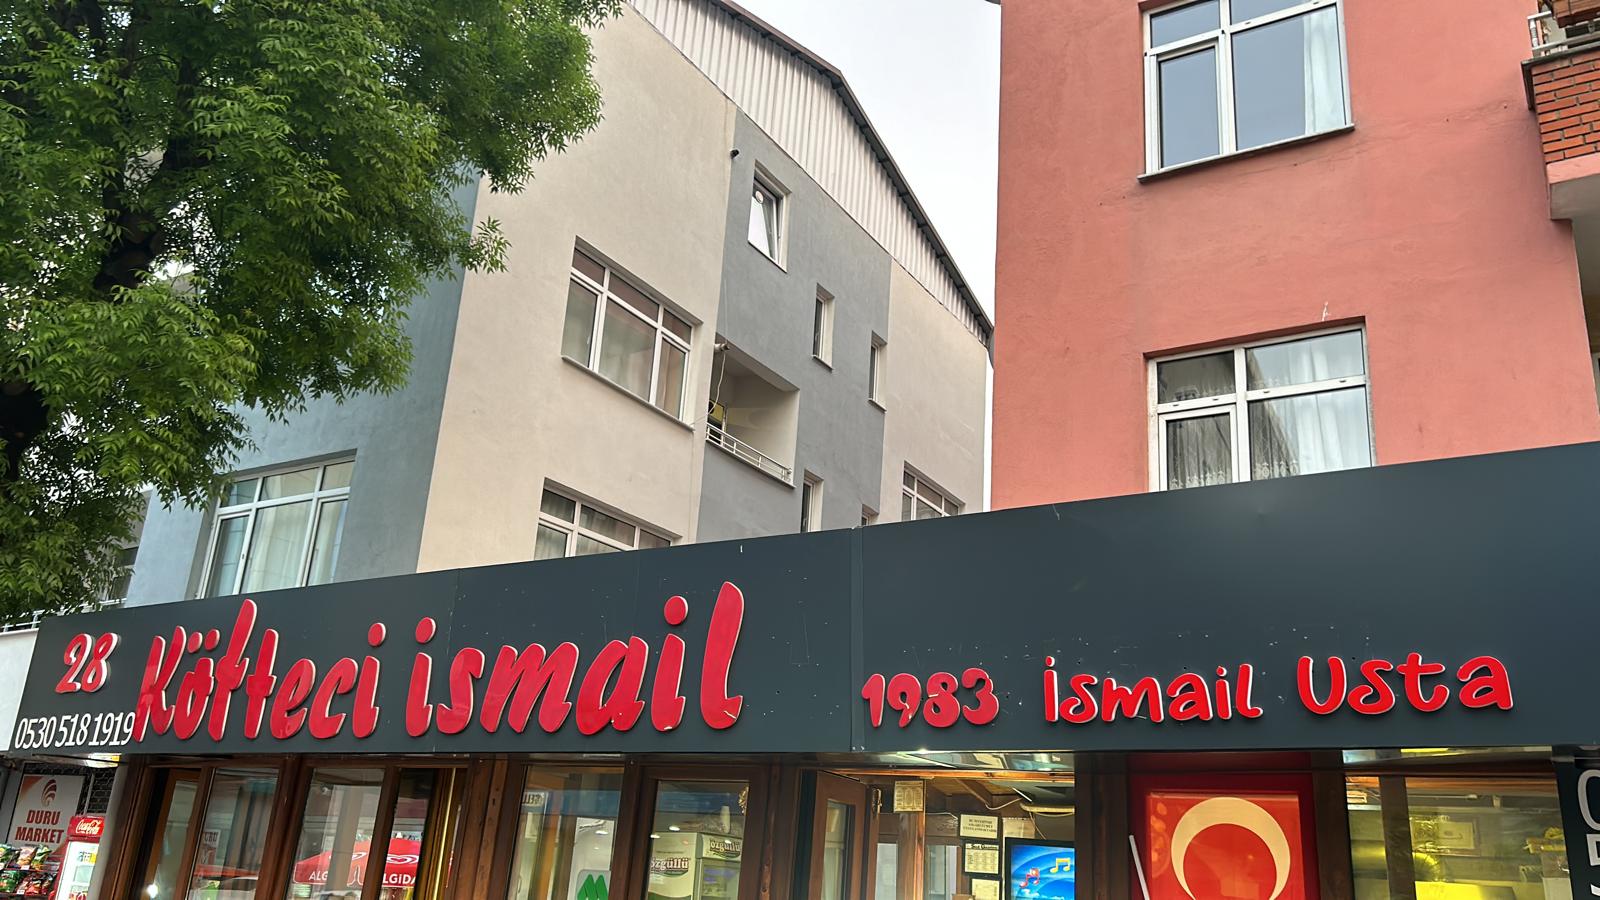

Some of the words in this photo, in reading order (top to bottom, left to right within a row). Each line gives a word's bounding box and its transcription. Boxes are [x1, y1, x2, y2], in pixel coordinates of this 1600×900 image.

[55, 632, 119, 694] 28
[132, 598, 387, 742] Köfteci
[861, 667, 1000, 728] 1983
[1296, 652, 1514, 715] Usta
[14, 716, 57, 749] 0530
[55, 713, 91, 748] 518
[88, 711, 136, 747] 1919
[14, 826, 65, 843] MARKET
[26, 809, 61, 826] DURU
